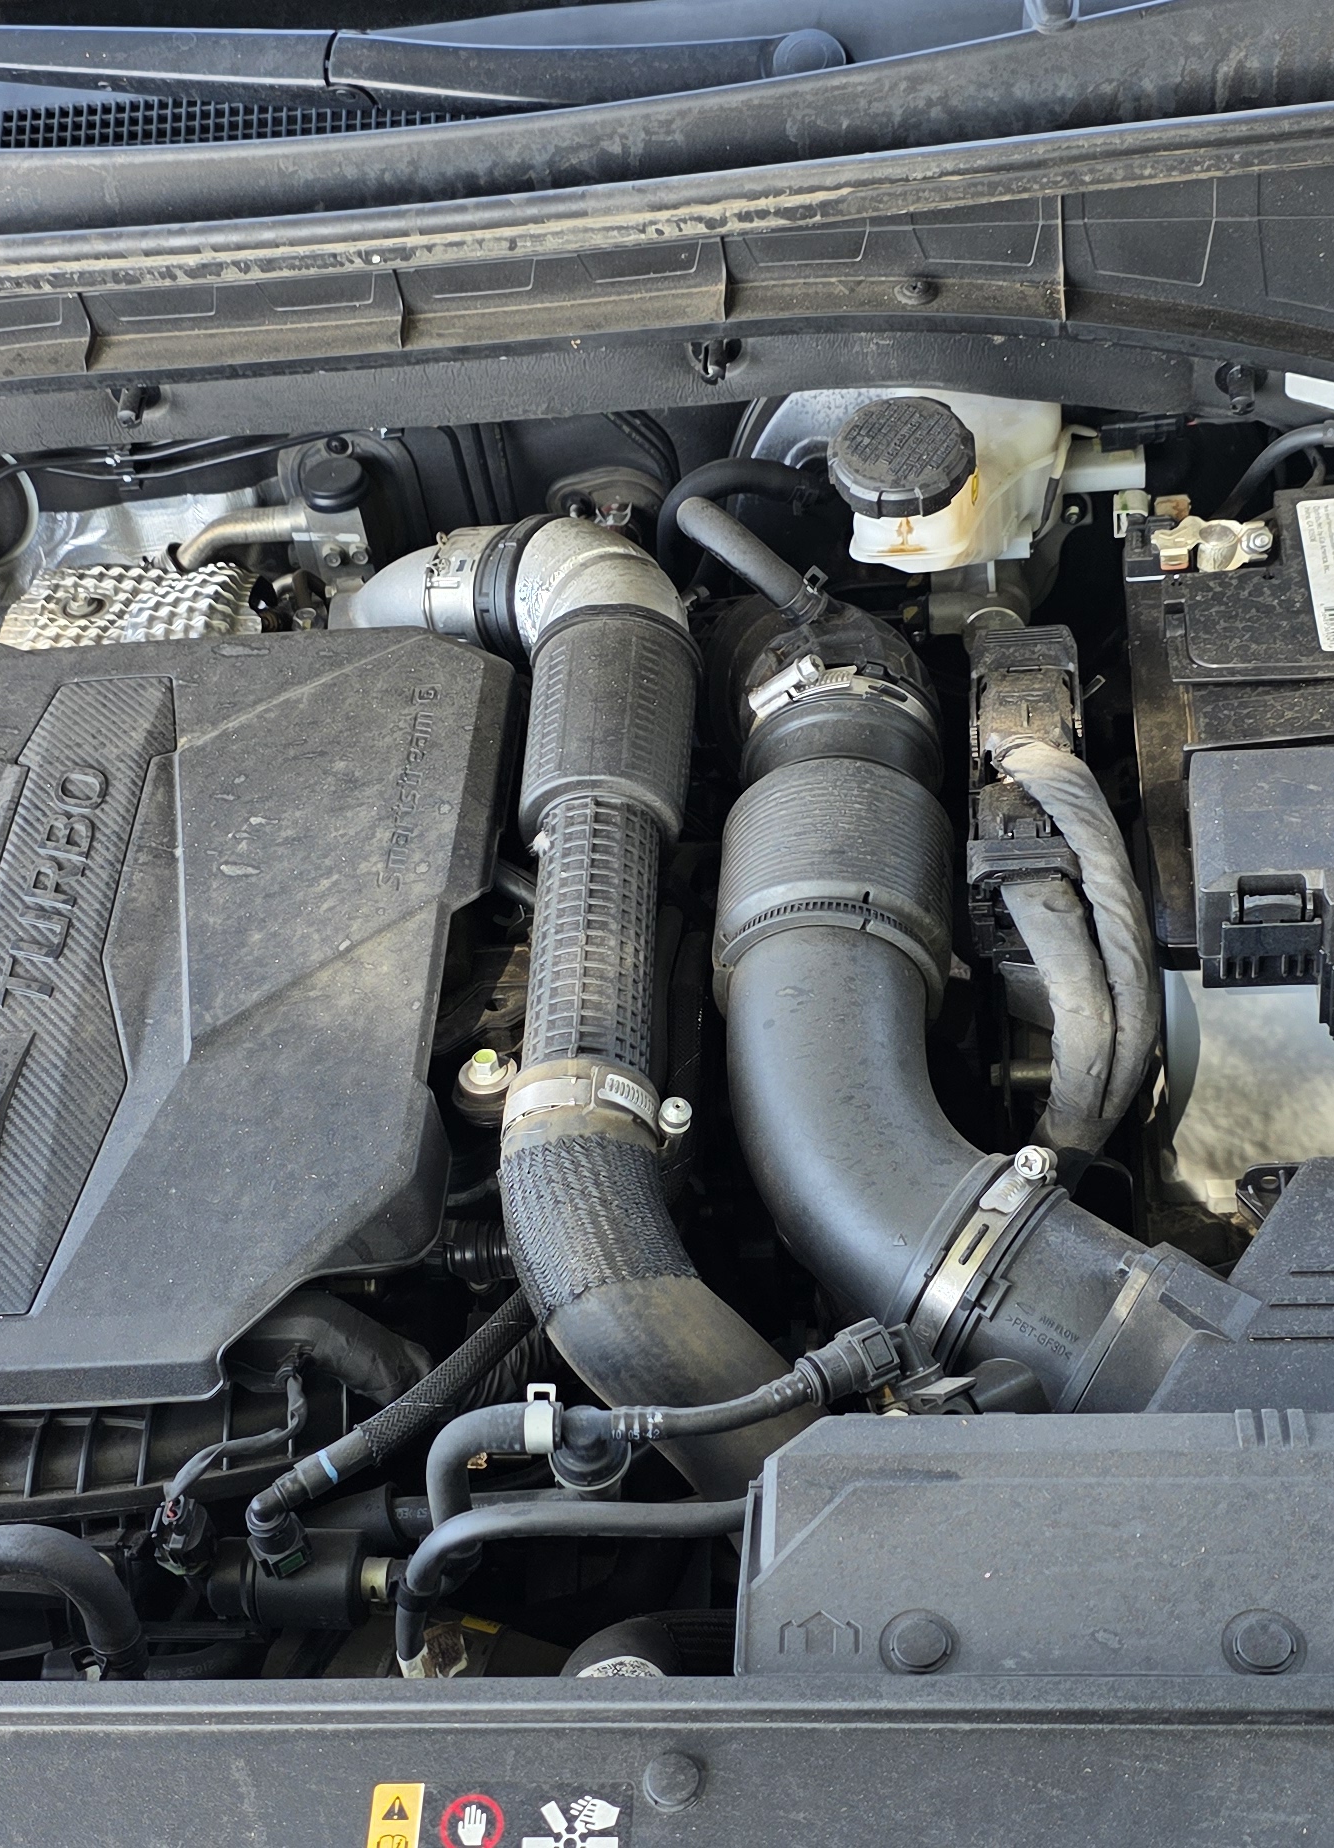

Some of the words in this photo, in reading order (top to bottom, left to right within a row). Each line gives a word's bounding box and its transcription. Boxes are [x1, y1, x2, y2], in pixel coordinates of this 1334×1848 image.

[376, 711, 435, 893] Smartstream
[1038, 1315, 1056, 1329] AIR
[1054, 1325, 1080, 1343] FLOW
